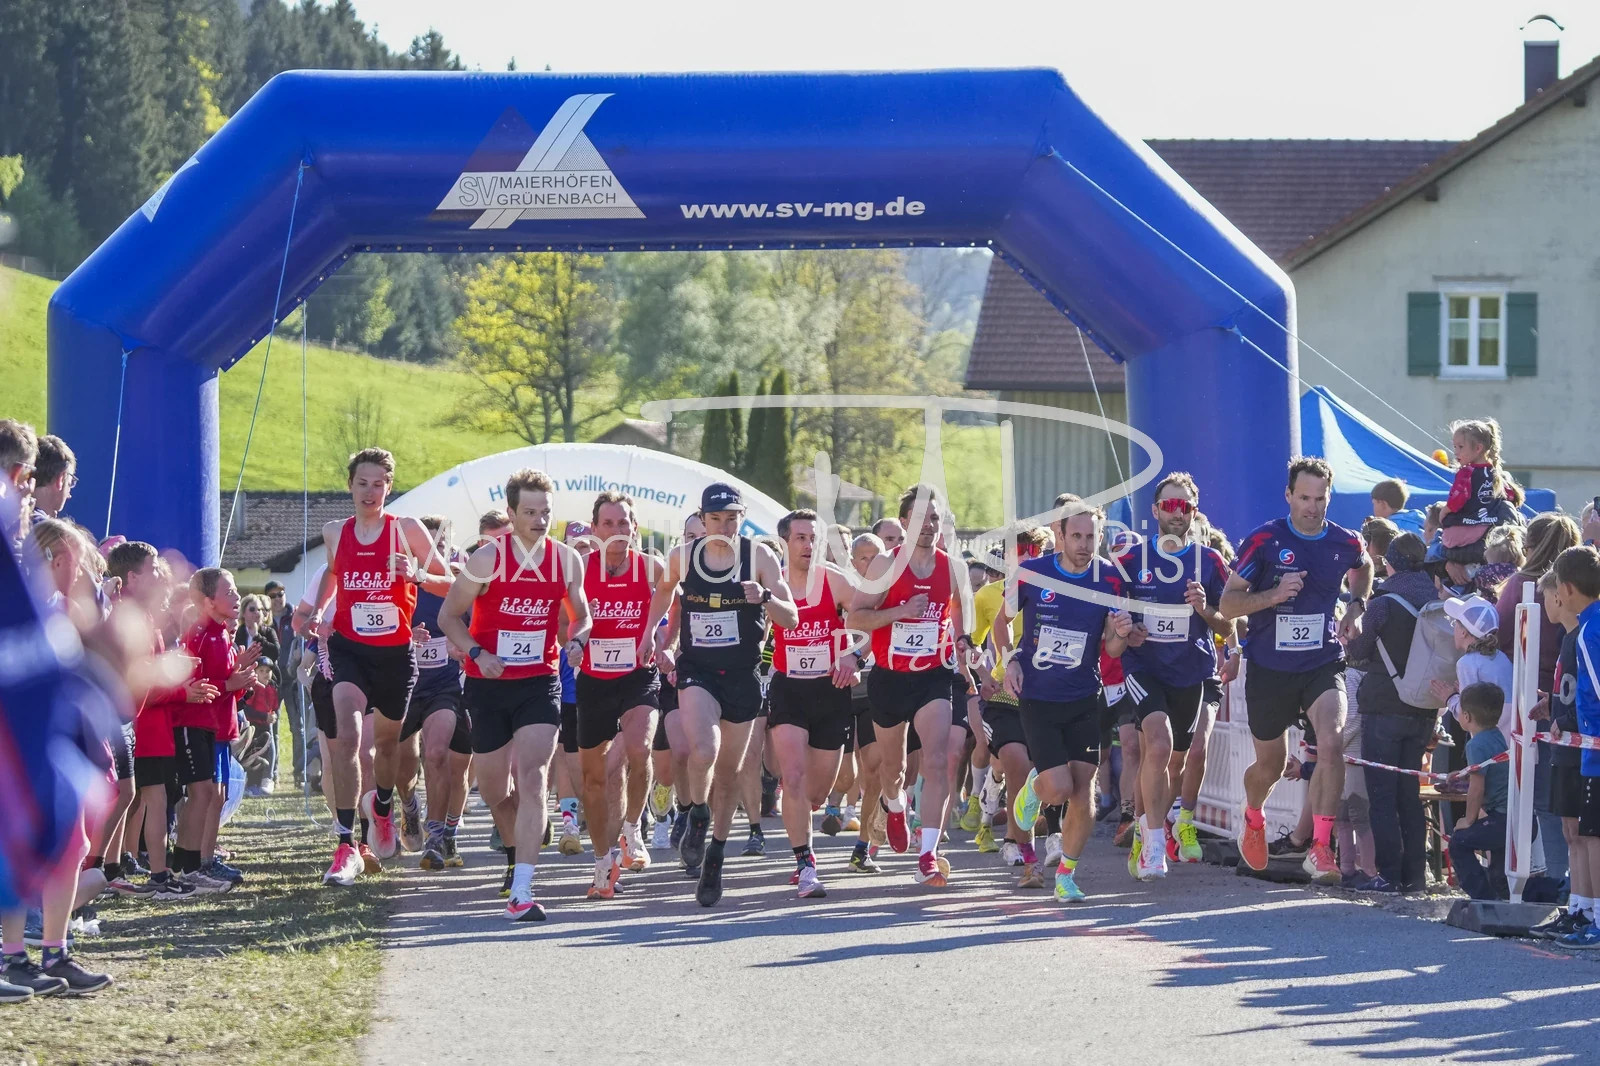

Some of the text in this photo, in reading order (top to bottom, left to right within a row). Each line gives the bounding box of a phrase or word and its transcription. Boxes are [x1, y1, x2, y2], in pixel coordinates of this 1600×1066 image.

[459, 173, 613, 206] SV MAIERHÖFEN
[496, 192, 617, 206] GRÜNENBACH
[680, 196, 926, 221] www.sv-mg.de
[565, 474, 687, 508] willkommen!
[343, 571, 393, 580] SPORT
[343, 579, 392, 588] HASCHKO
[366, 590, 394, 601] Team
[499, 602, 550, 614] HASCHKO
[502, 597, 554, 607] SPORT
[592, 601, 643, 610] SPORT
[592, 609, 642, 617] HASCHKO
[366, 614, 384, 626] 38
[522, 616, 549, 626] Team
[615, 619, 641, 629] Team
[704, 624, 723, 637] 28
[1157, 620, 1175, 633] 54
[783, 628, 830, 638] HASCHKO
[1292, 627, 1310, 640] 32
[905, 634, 924, 647] 42
[421, 648, 438, 660] 43
[512, 642, 531, 655] 24
[604, 649, 621, 662] 77
[799, 657, 816, 669] 67
